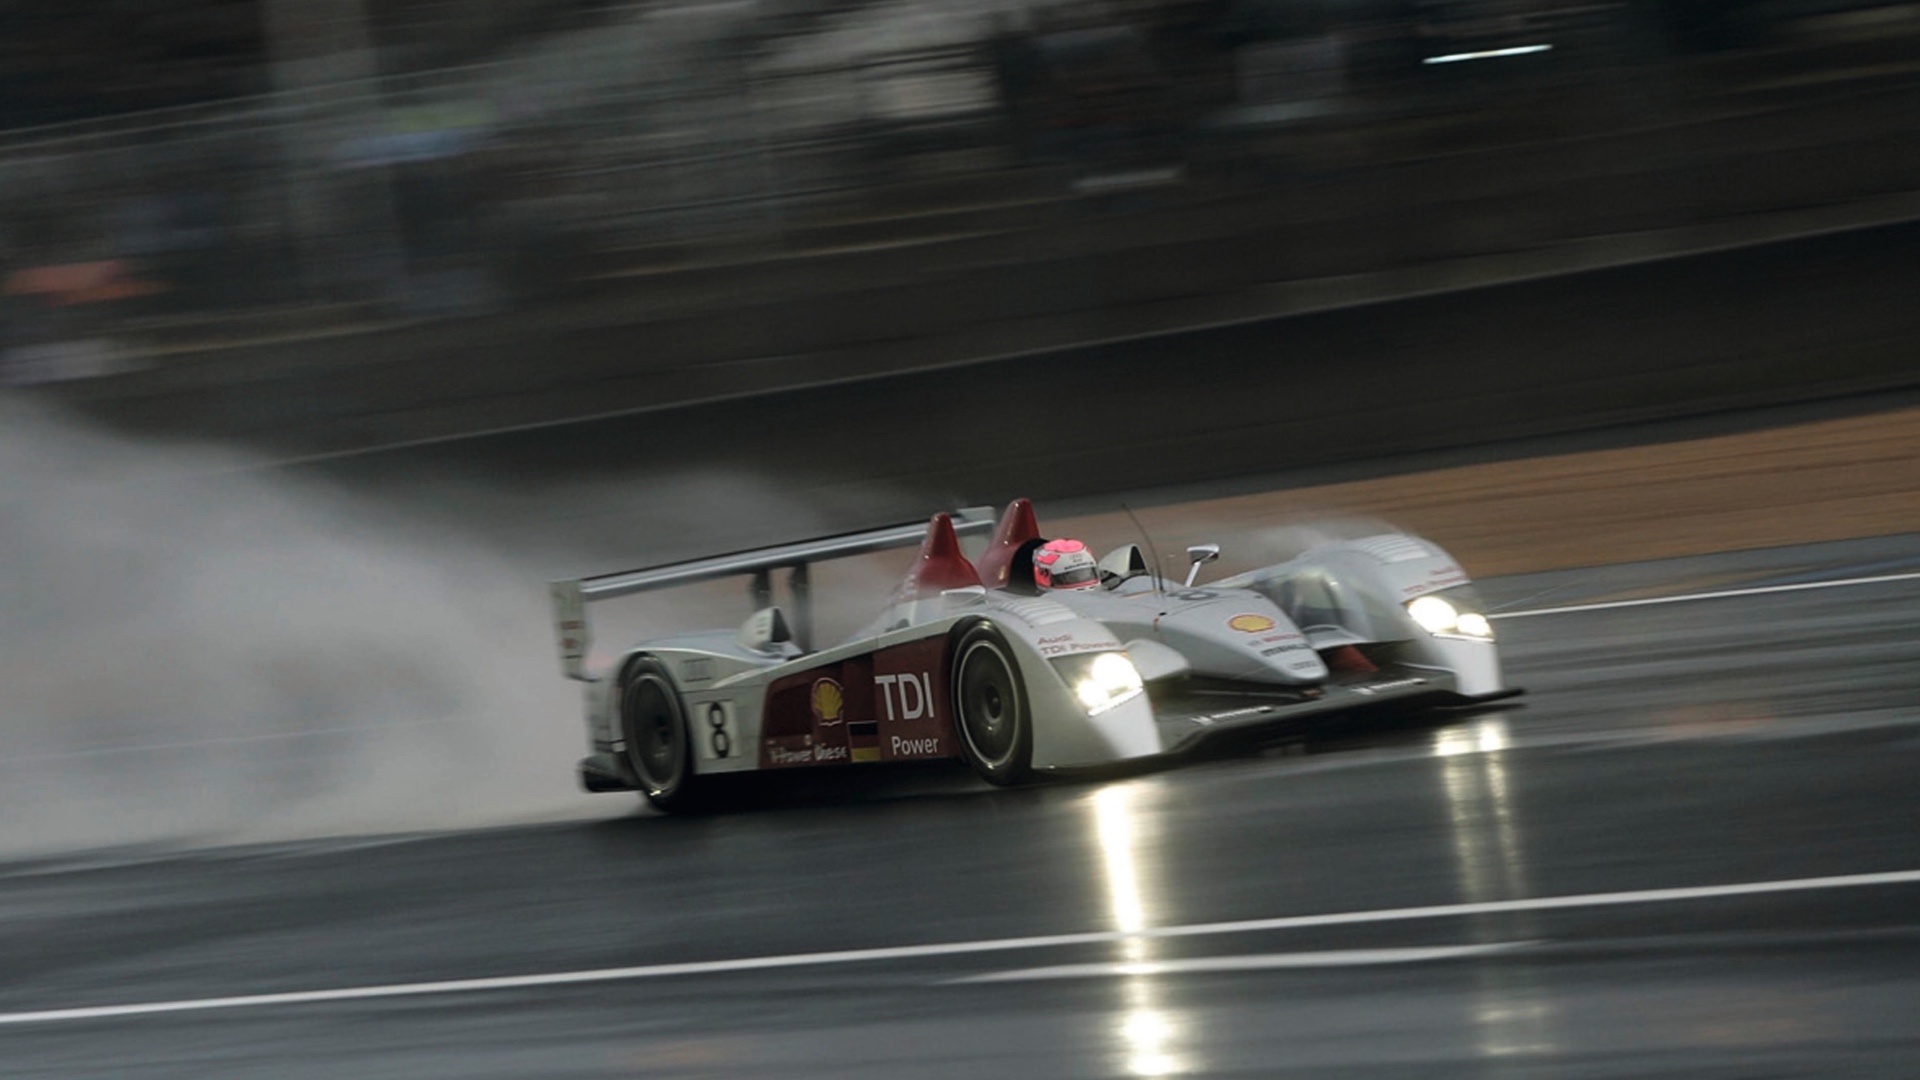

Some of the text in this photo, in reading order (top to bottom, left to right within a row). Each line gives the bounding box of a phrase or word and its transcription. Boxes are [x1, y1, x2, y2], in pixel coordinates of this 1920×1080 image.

[874, 672, 935, 721] TDI
[708, 701, 731, 759] 8
[891, 735, 939, 756] Power
